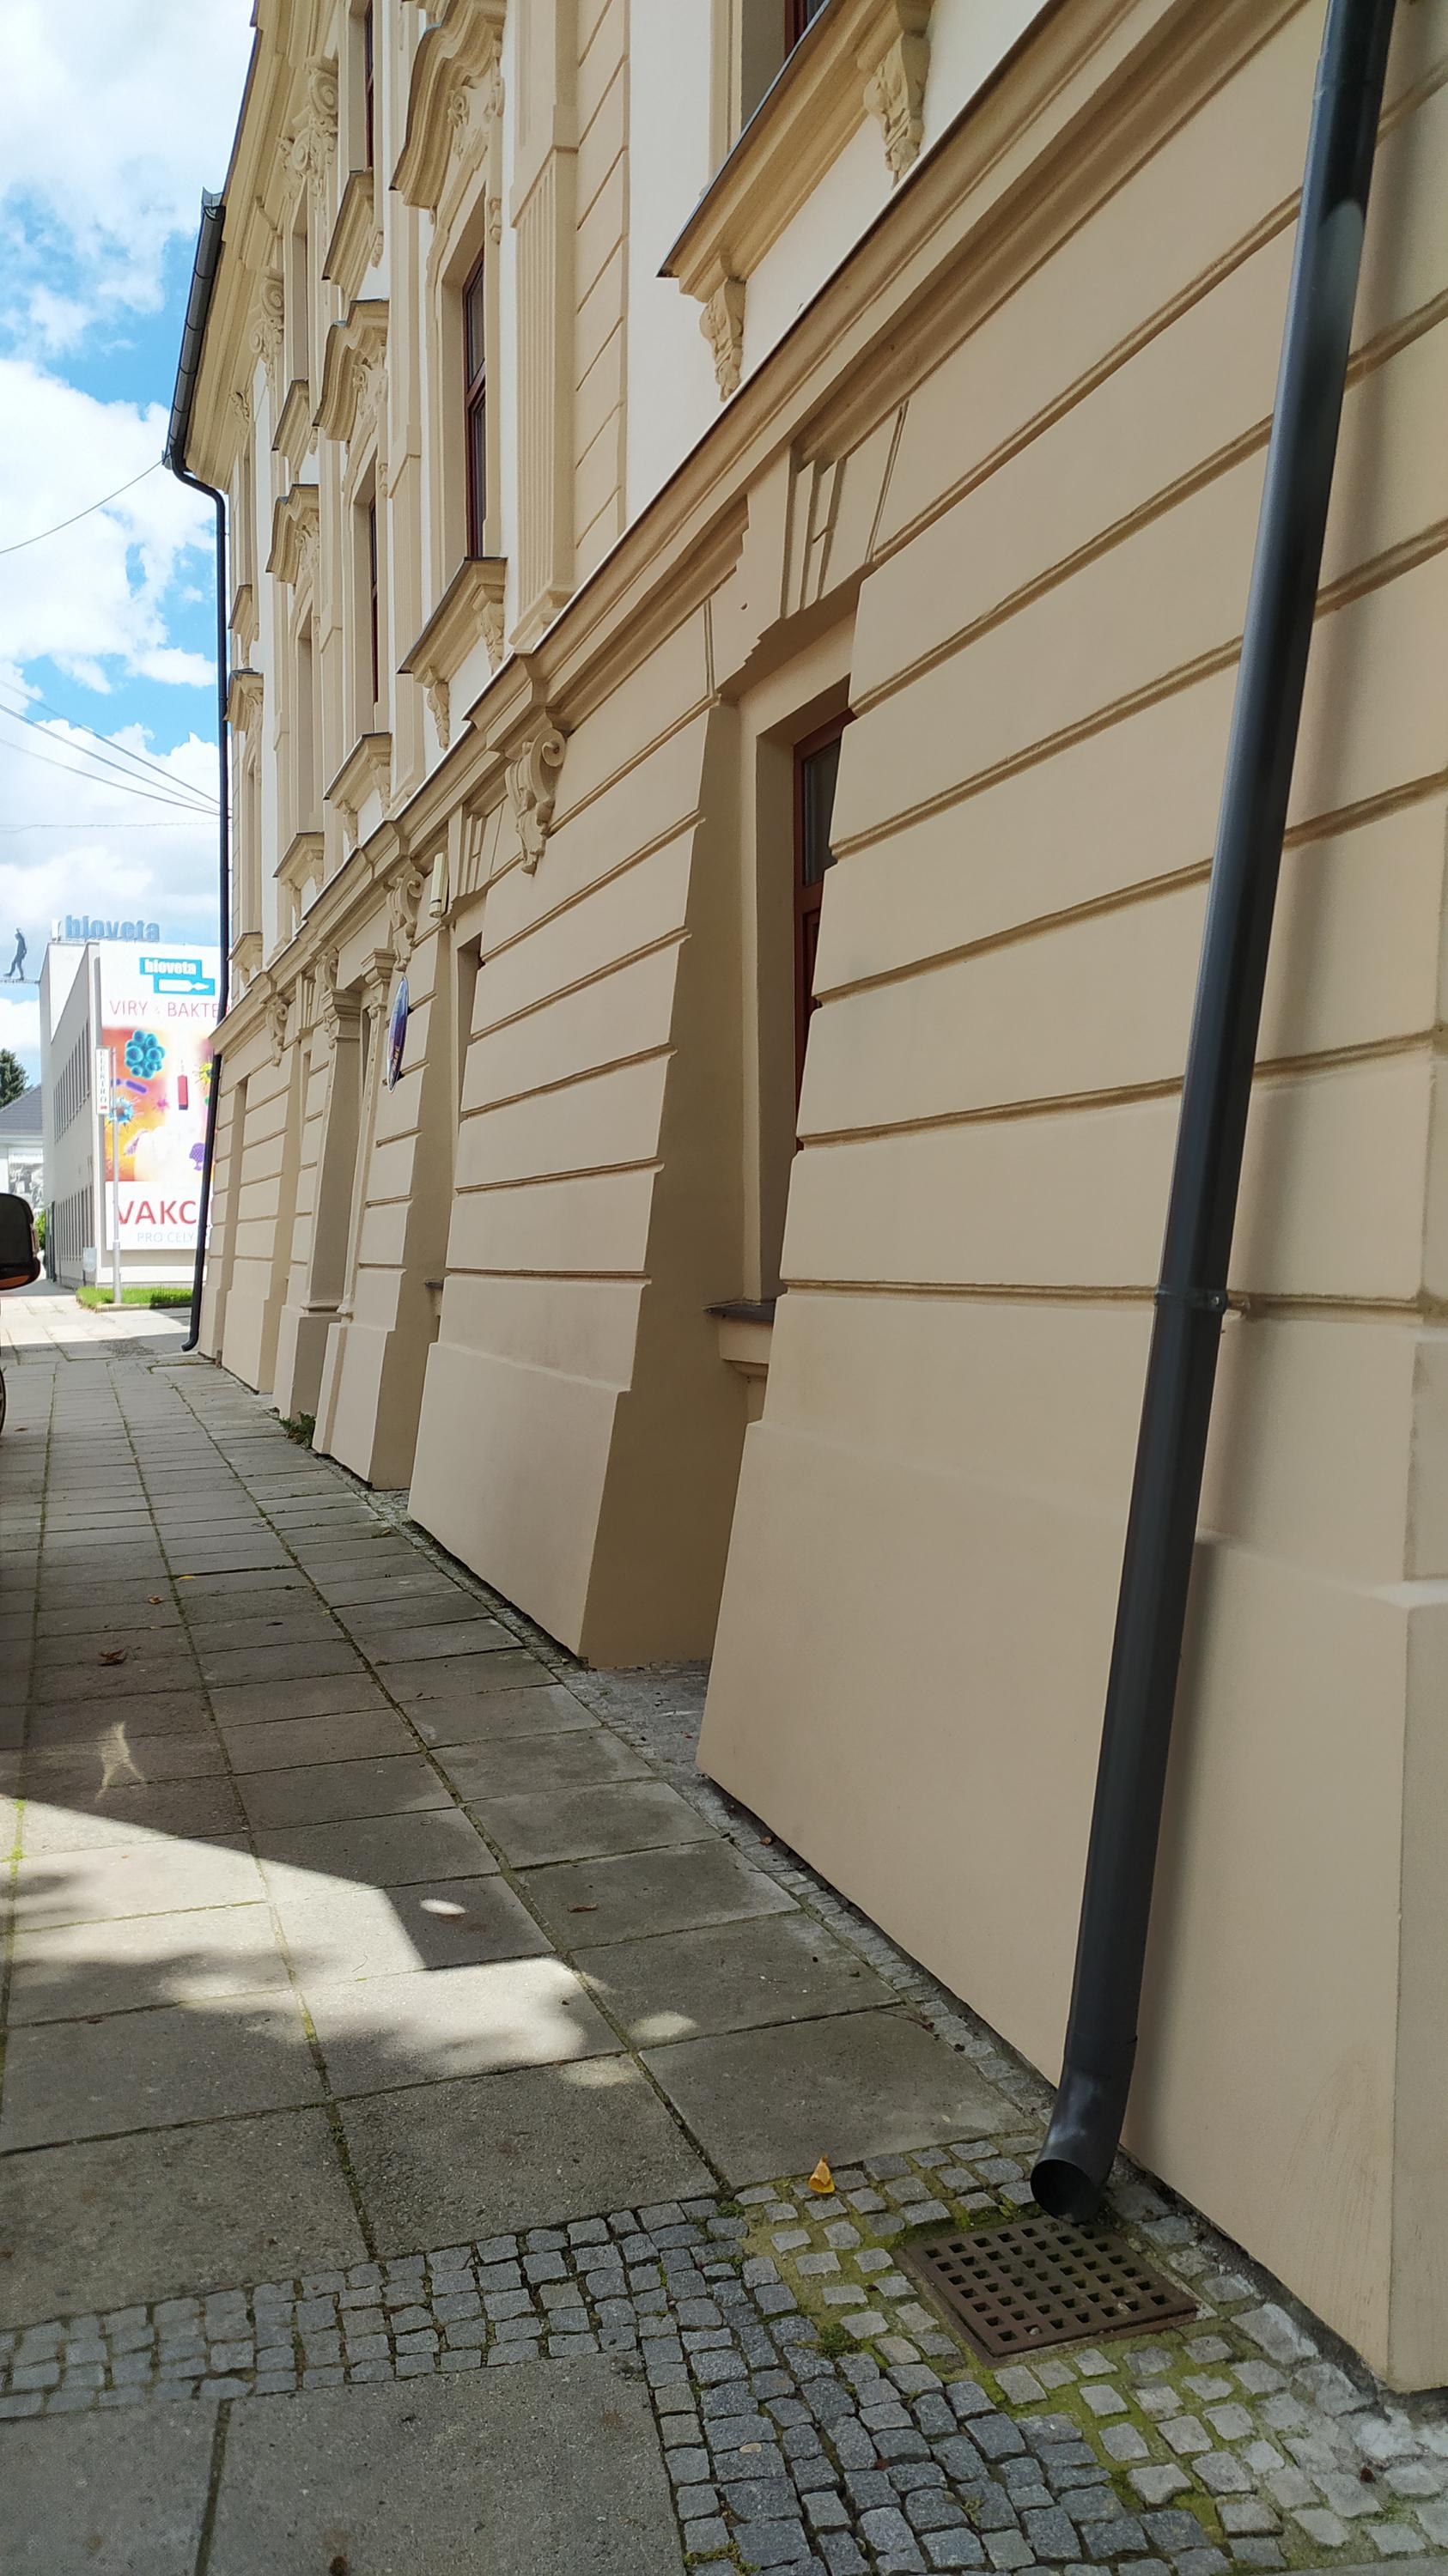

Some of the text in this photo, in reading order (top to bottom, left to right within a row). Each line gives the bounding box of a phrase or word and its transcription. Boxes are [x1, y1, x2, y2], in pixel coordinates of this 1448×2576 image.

[65, 914, 160, 942] bioveta
[144, 958, 197, 975] bioveta
[109, 999, 148, 1017] VIRY
[118, 1200, 197, 1224] VAKC
[137, 1231, 163, 1243] PRO
